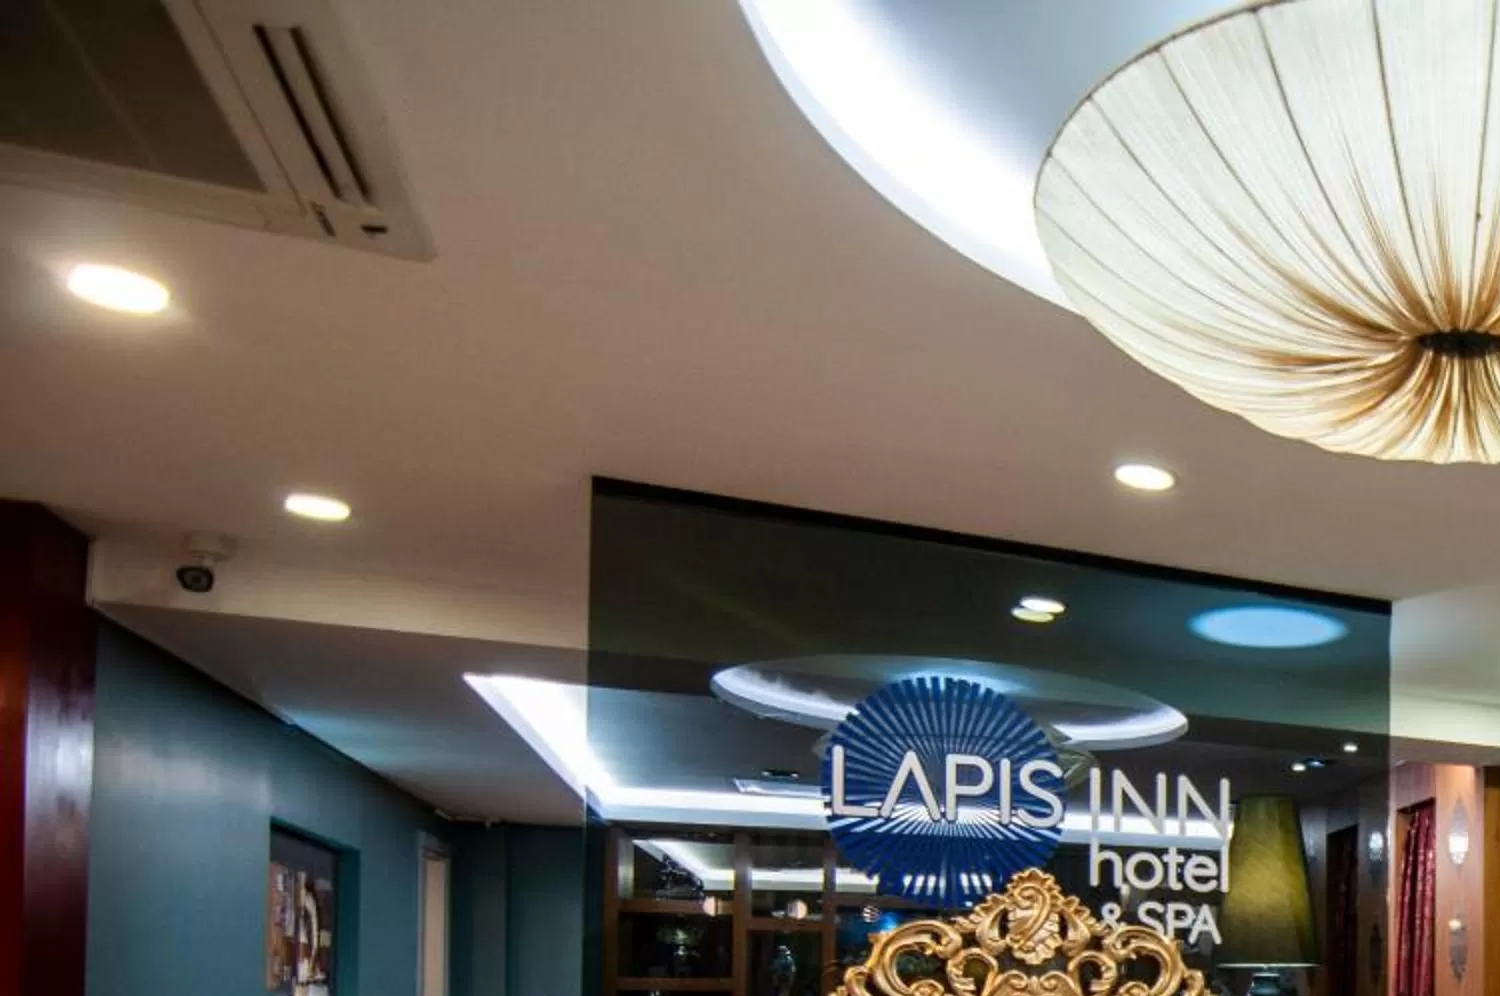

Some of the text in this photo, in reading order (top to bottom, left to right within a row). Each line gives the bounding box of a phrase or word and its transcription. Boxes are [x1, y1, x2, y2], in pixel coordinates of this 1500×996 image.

[832, 744, 1229, 838] LAPIS INN
[1089, 839, 1229, 893] hotel
[1137, 901, 1222, 945] SPA
